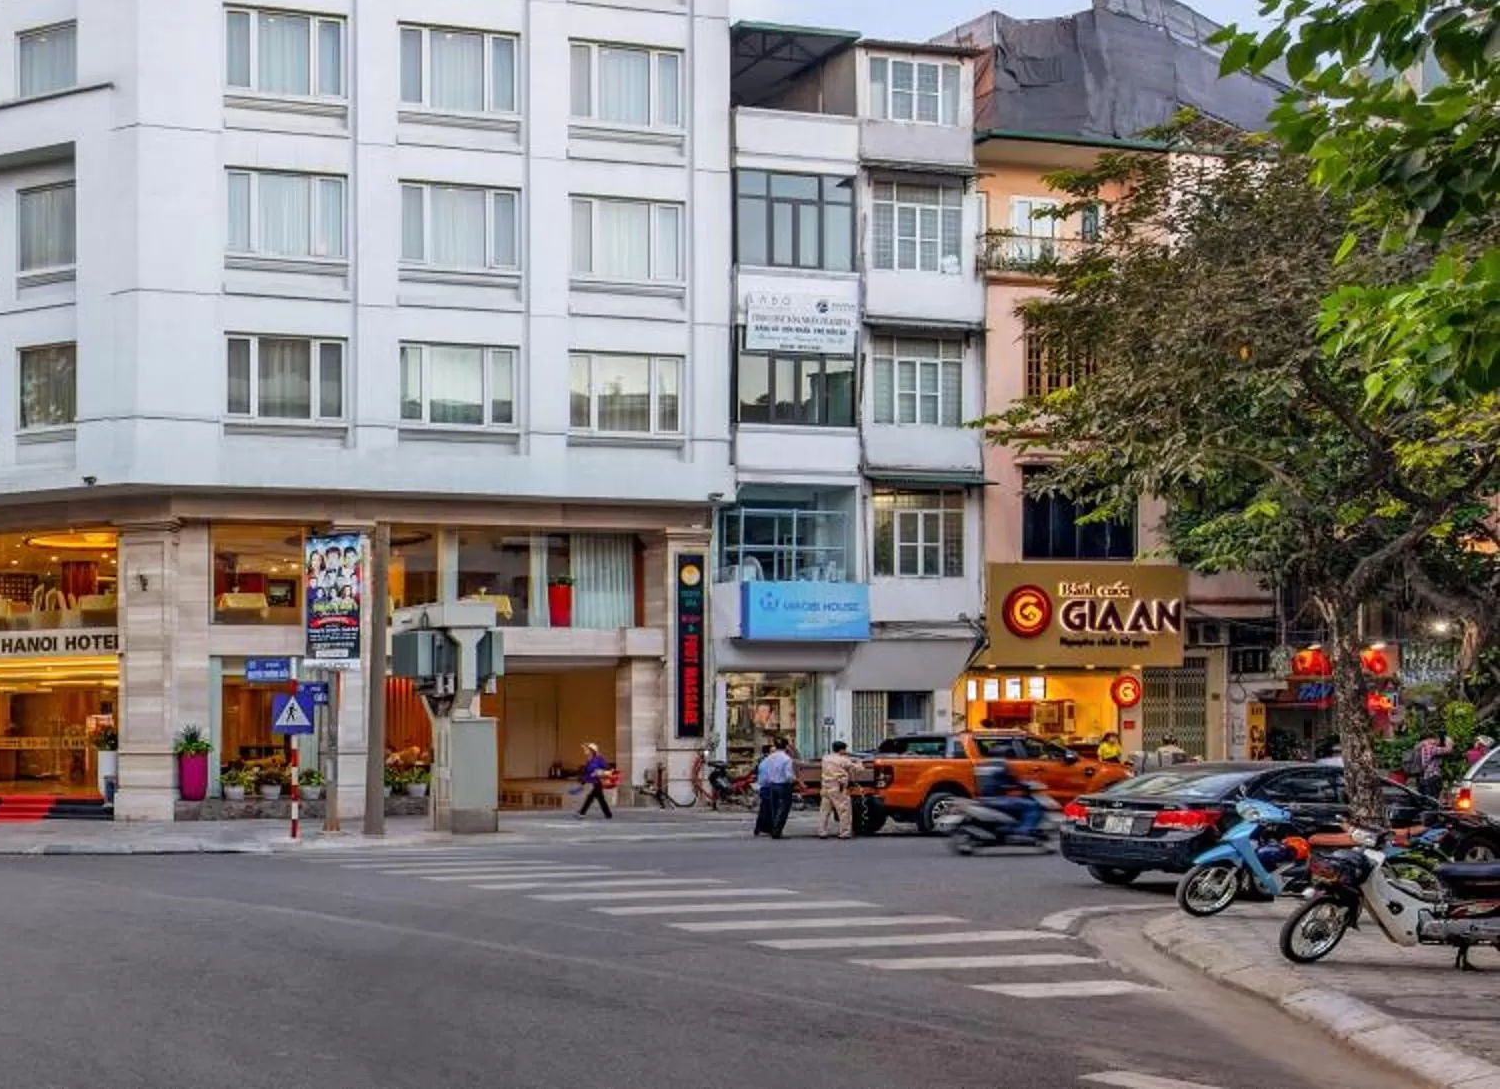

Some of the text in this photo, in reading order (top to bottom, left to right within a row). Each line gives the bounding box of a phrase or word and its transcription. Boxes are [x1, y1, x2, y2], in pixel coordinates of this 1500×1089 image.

[1, 636, 58, 653] HANOI
[683, 634, 698, 726] FOOT MASSAGE
